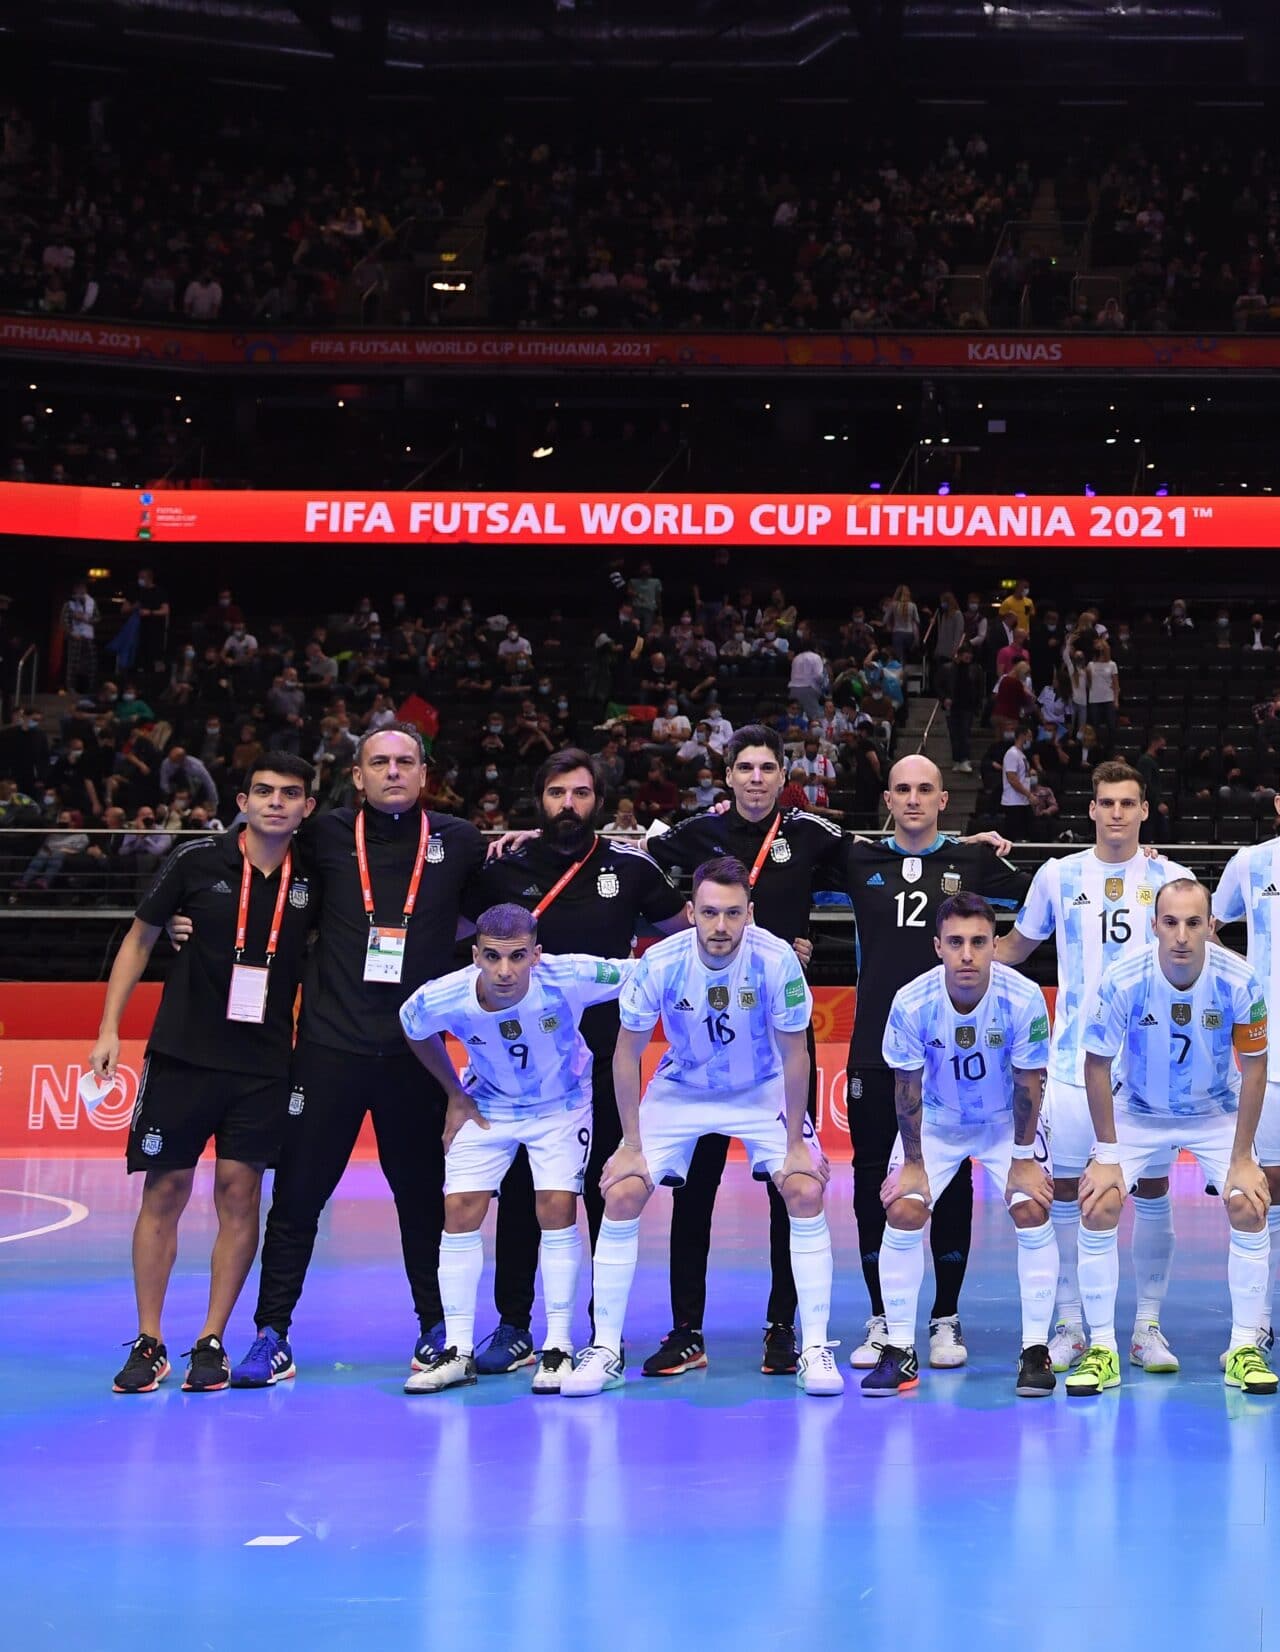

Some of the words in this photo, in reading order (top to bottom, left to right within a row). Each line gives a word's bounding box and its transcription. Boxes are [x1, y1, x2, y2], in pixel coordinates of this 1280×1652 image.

[311, 341, 344, 354] FIFA
[350, 341, 409, 354] FUTSAL
[415, 341, 478, 354] WORLD
[482, 341, 514, 354] CUP
[518, 342, 607, 354] LITHUANIA
[967, 343, 1063, 361] KAUNAS
[305, 501, 395, 533] FIFA
[409, 501, 566, 534] FUTSAL
[579, 502, 735, 535] WORLD
[749, 503, 832, 536] CUP
[846, 504, 1076, 537] LITHUANIA
[894, 891, 928, 927] 12
[1098, 910, 1132, 944] 15
[703, 1013, 736, 1046] 16
[509, 1044, 529, 1070] 9
[1171, 1034, 1192, 1065] 7
[949, 1052, 987, 1081] 10
[578, 1127, 591, 1164] 9
